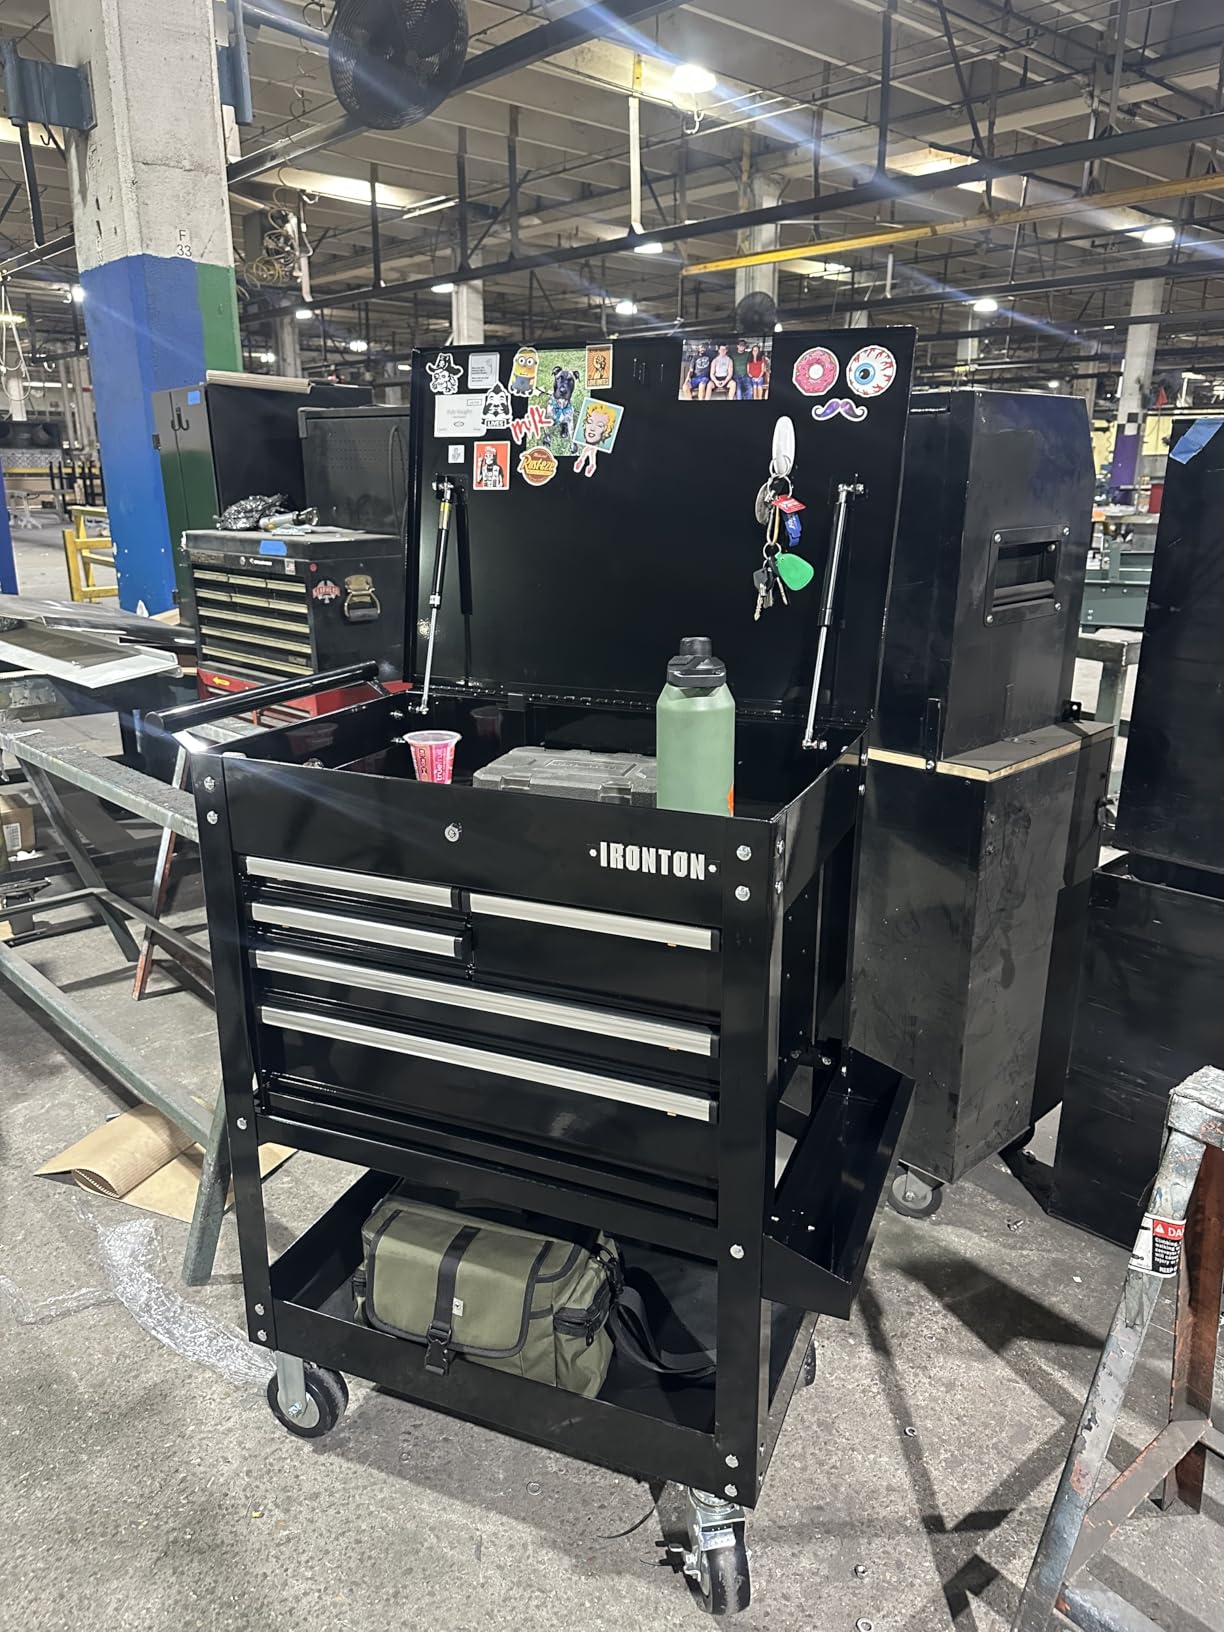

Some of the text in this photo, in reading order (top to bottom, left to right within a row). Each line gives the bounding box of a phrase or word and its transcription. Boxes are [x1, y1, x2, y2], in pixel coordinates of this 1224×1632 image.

[179, 229, 186, 241] F
[176, 243, 192, 257] 33
[511, 406, 552, 442] milk
[600, 841, 705, 880] IRONTON
